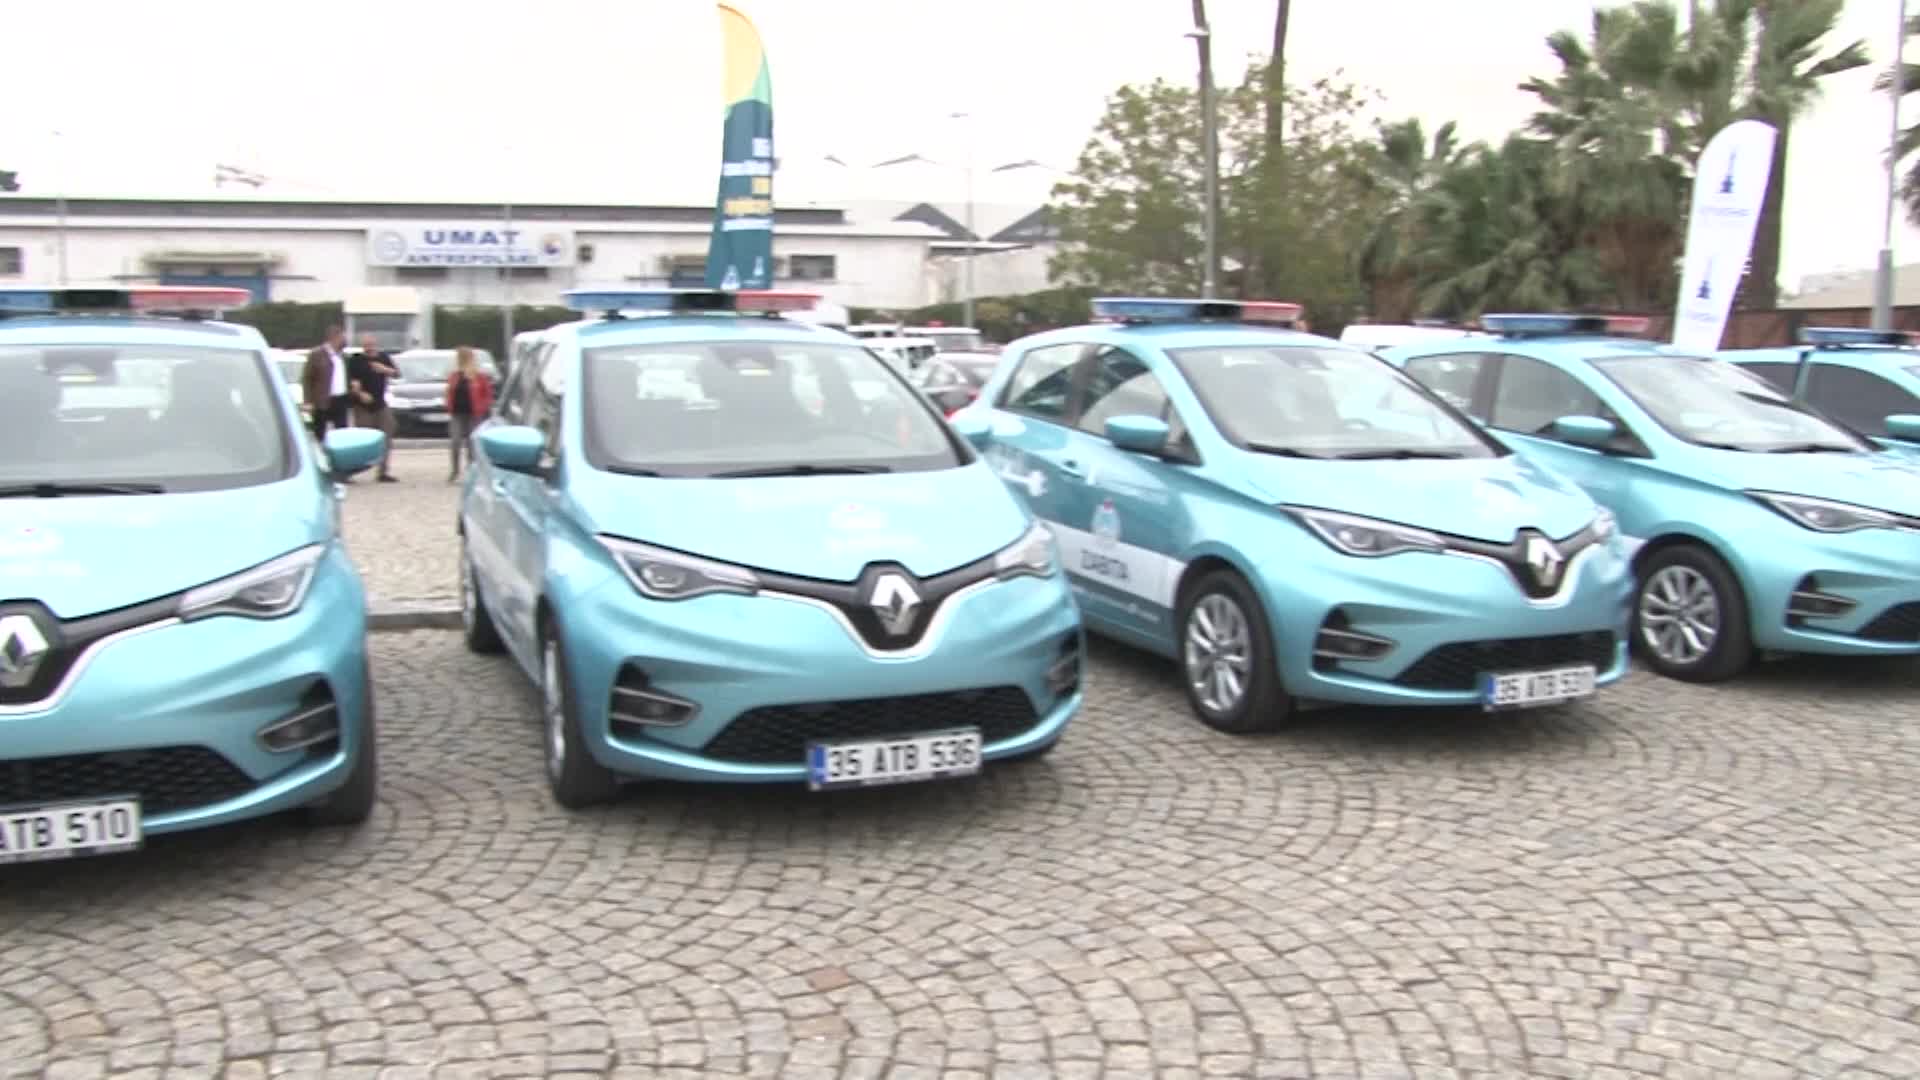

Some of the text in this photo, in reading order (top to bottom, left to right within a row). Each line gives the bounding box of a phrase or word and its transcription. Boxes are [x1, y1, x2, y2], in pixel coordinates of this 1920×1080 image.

[424, 229, 521, 245] UMAT
[1496, 677, 1520, 701] 35
[1525, 674, 1557, 698] ATB
[829, 738, 976, 777] 35 ATB 536
[66, 807, 132, 845] 510
